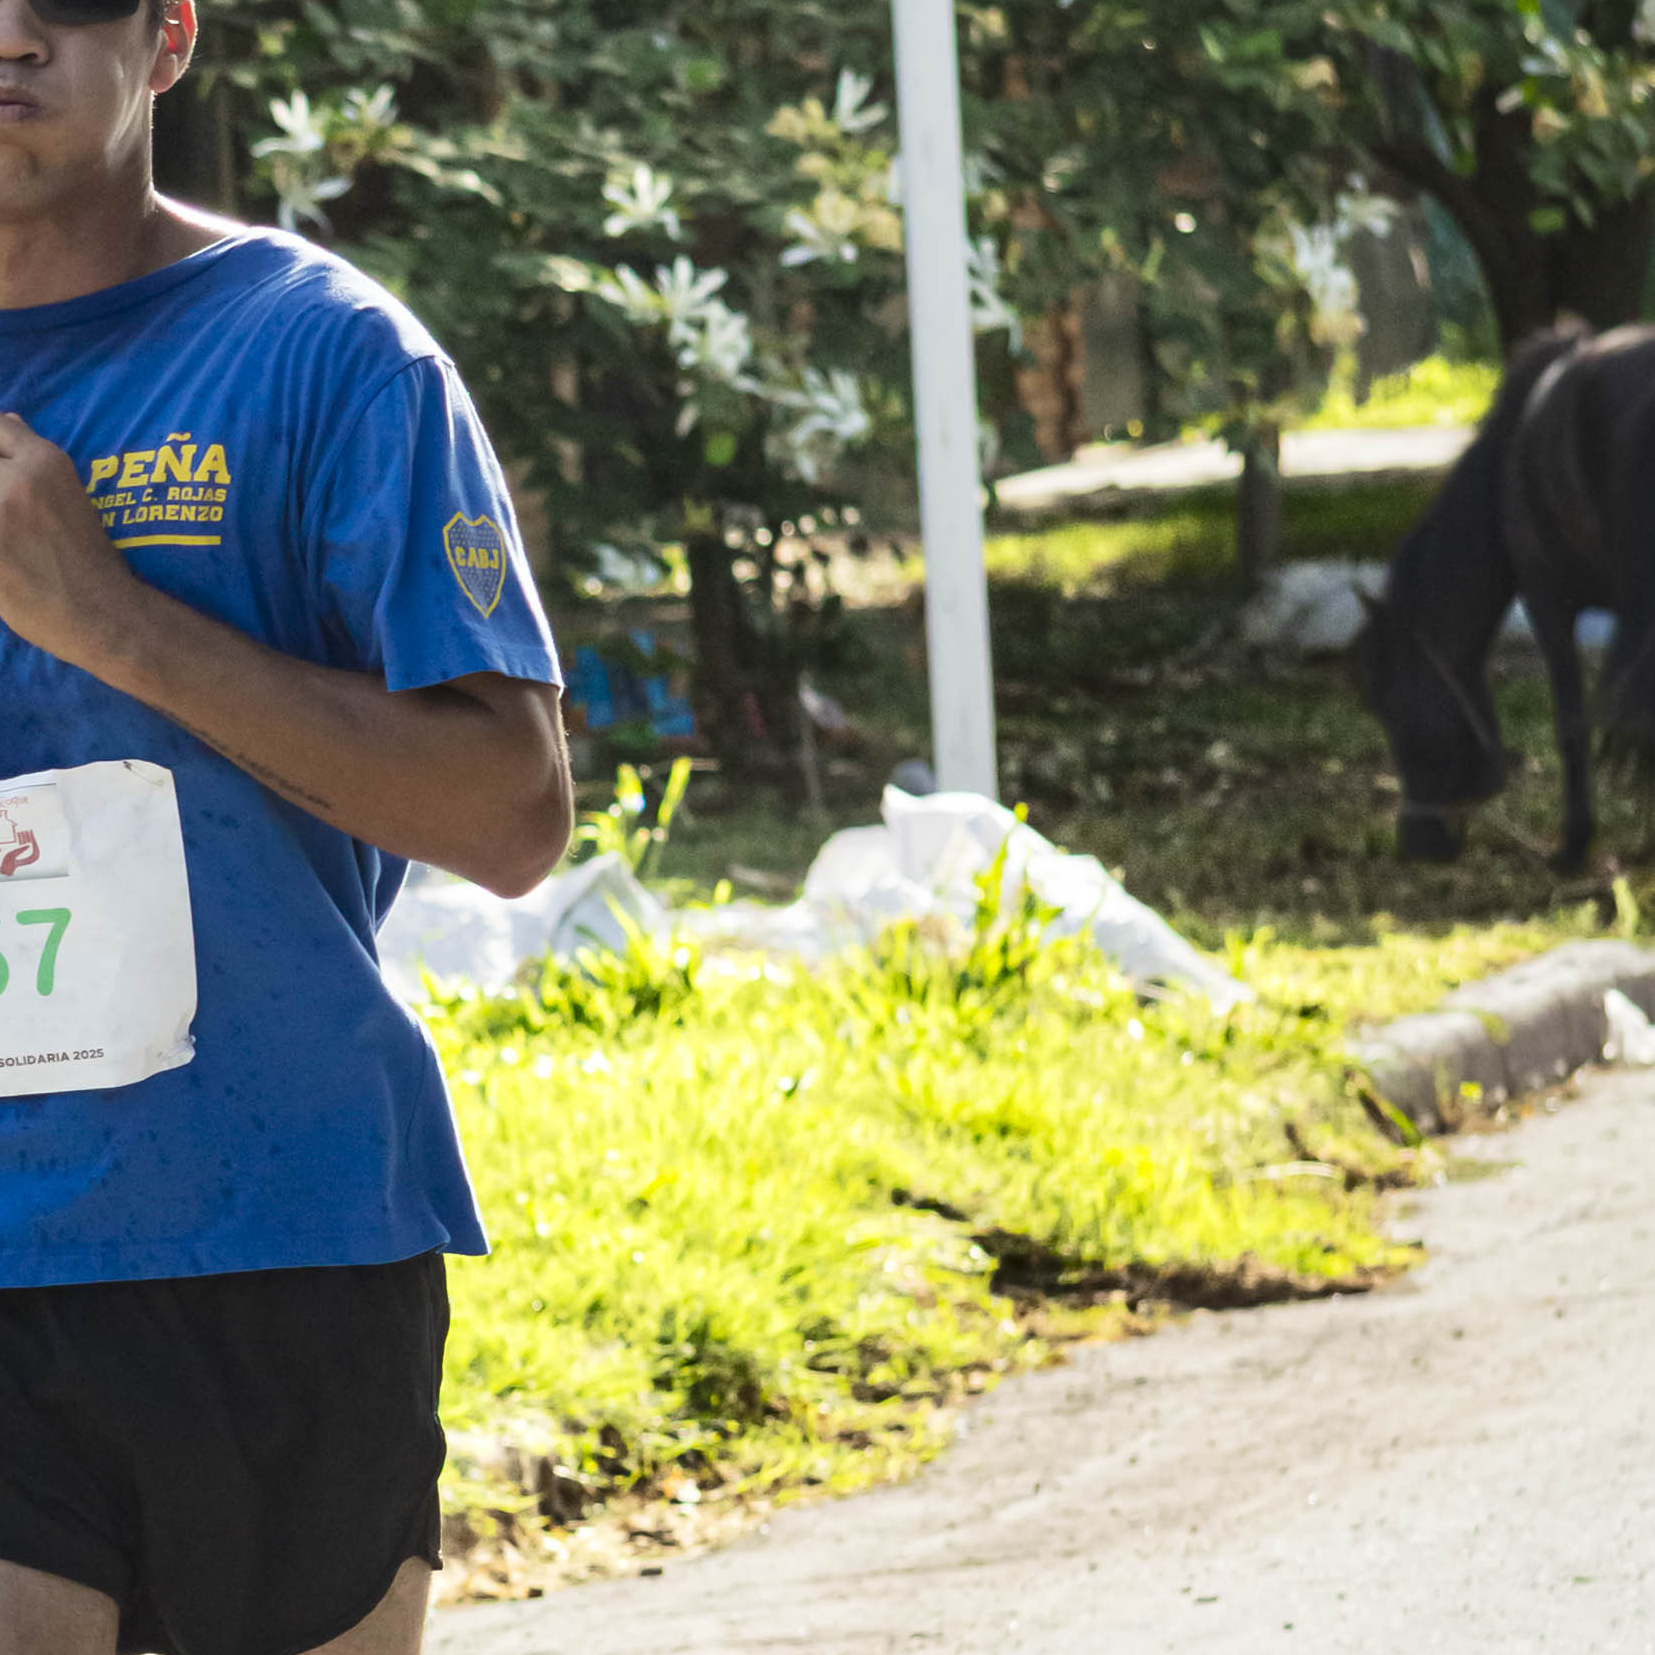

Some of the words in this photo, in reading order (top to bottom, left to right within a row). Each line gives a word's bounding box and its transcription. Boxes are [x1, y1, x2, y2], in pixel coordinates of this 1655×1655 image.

[85, 432, 231, 493] PEÑA
[90, 493, 137, 509] NGEL
[167, 487, 227, 502] ROJAS
[122, 505, 224, 524] LORENZO
[73, 1048, 104, 1061] 2025
